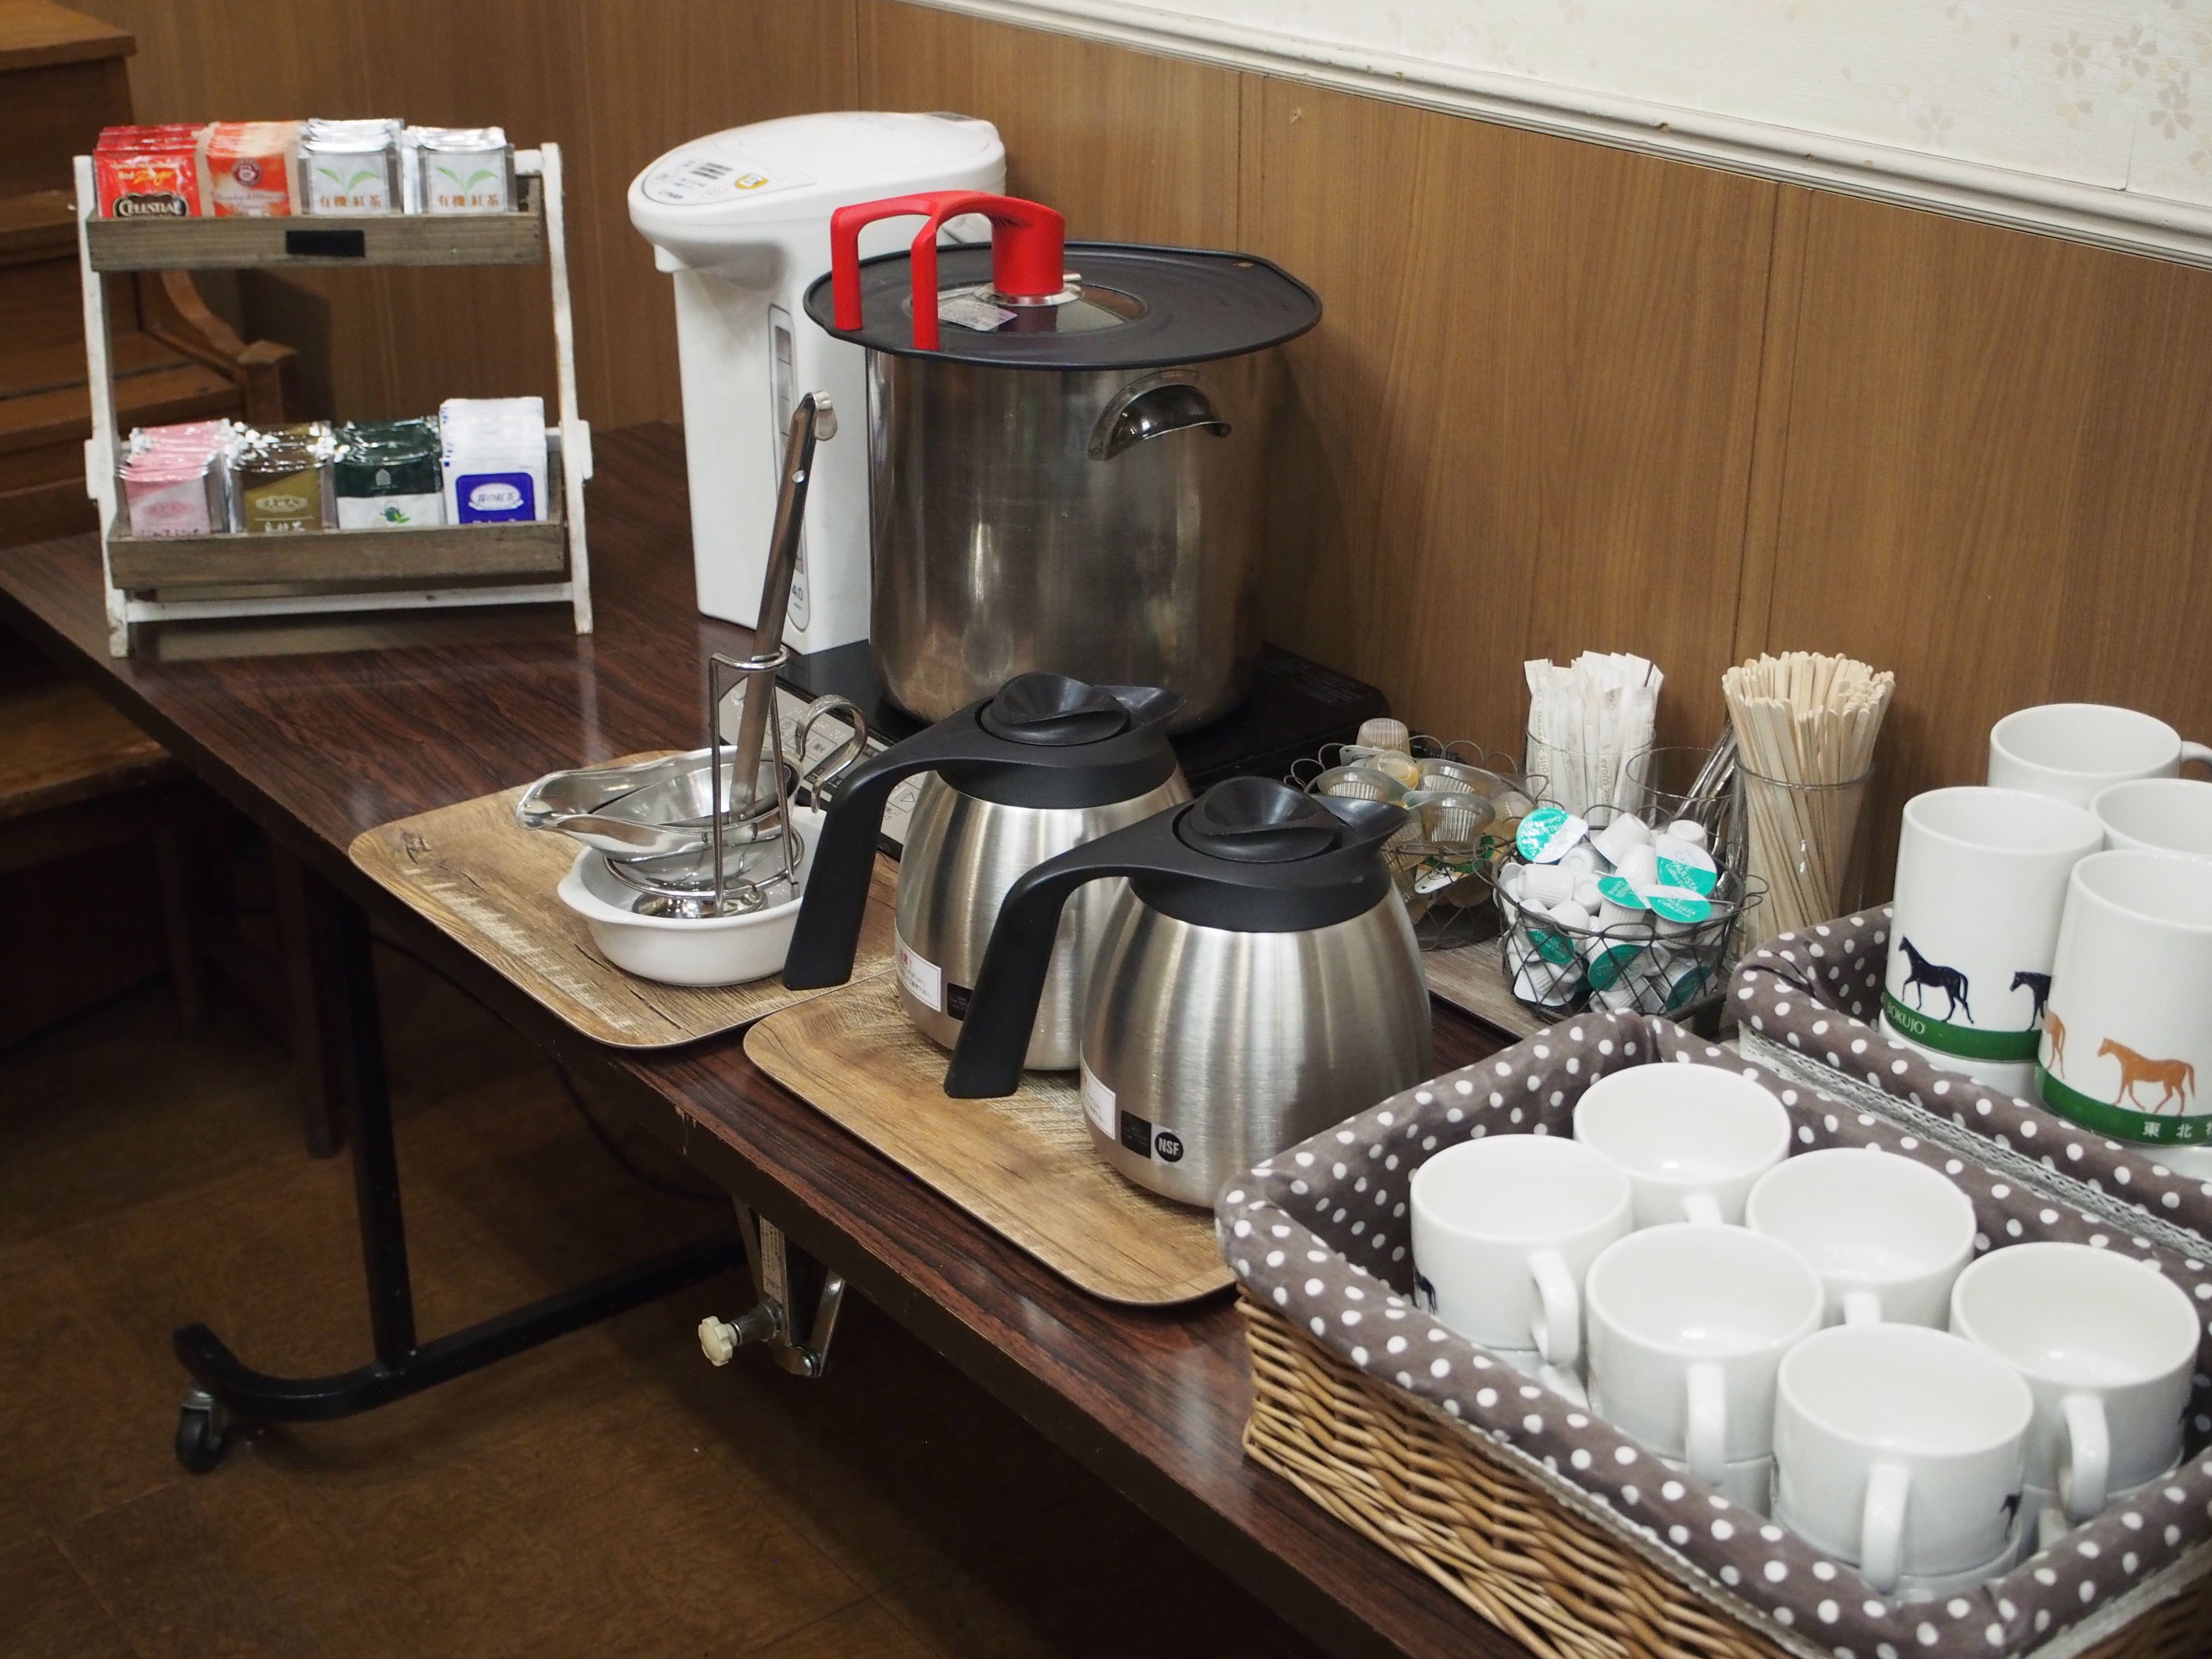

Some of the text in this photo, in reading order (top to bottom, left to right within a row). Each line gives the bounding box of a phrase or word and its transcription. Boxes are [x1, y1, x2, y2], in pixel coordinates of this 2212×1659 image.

[320, 194, 381, 208] 有機紅茶
[438, 194, 499, 207] 有機紅茶
[1158, 1137, 1180, 1157] NSF
